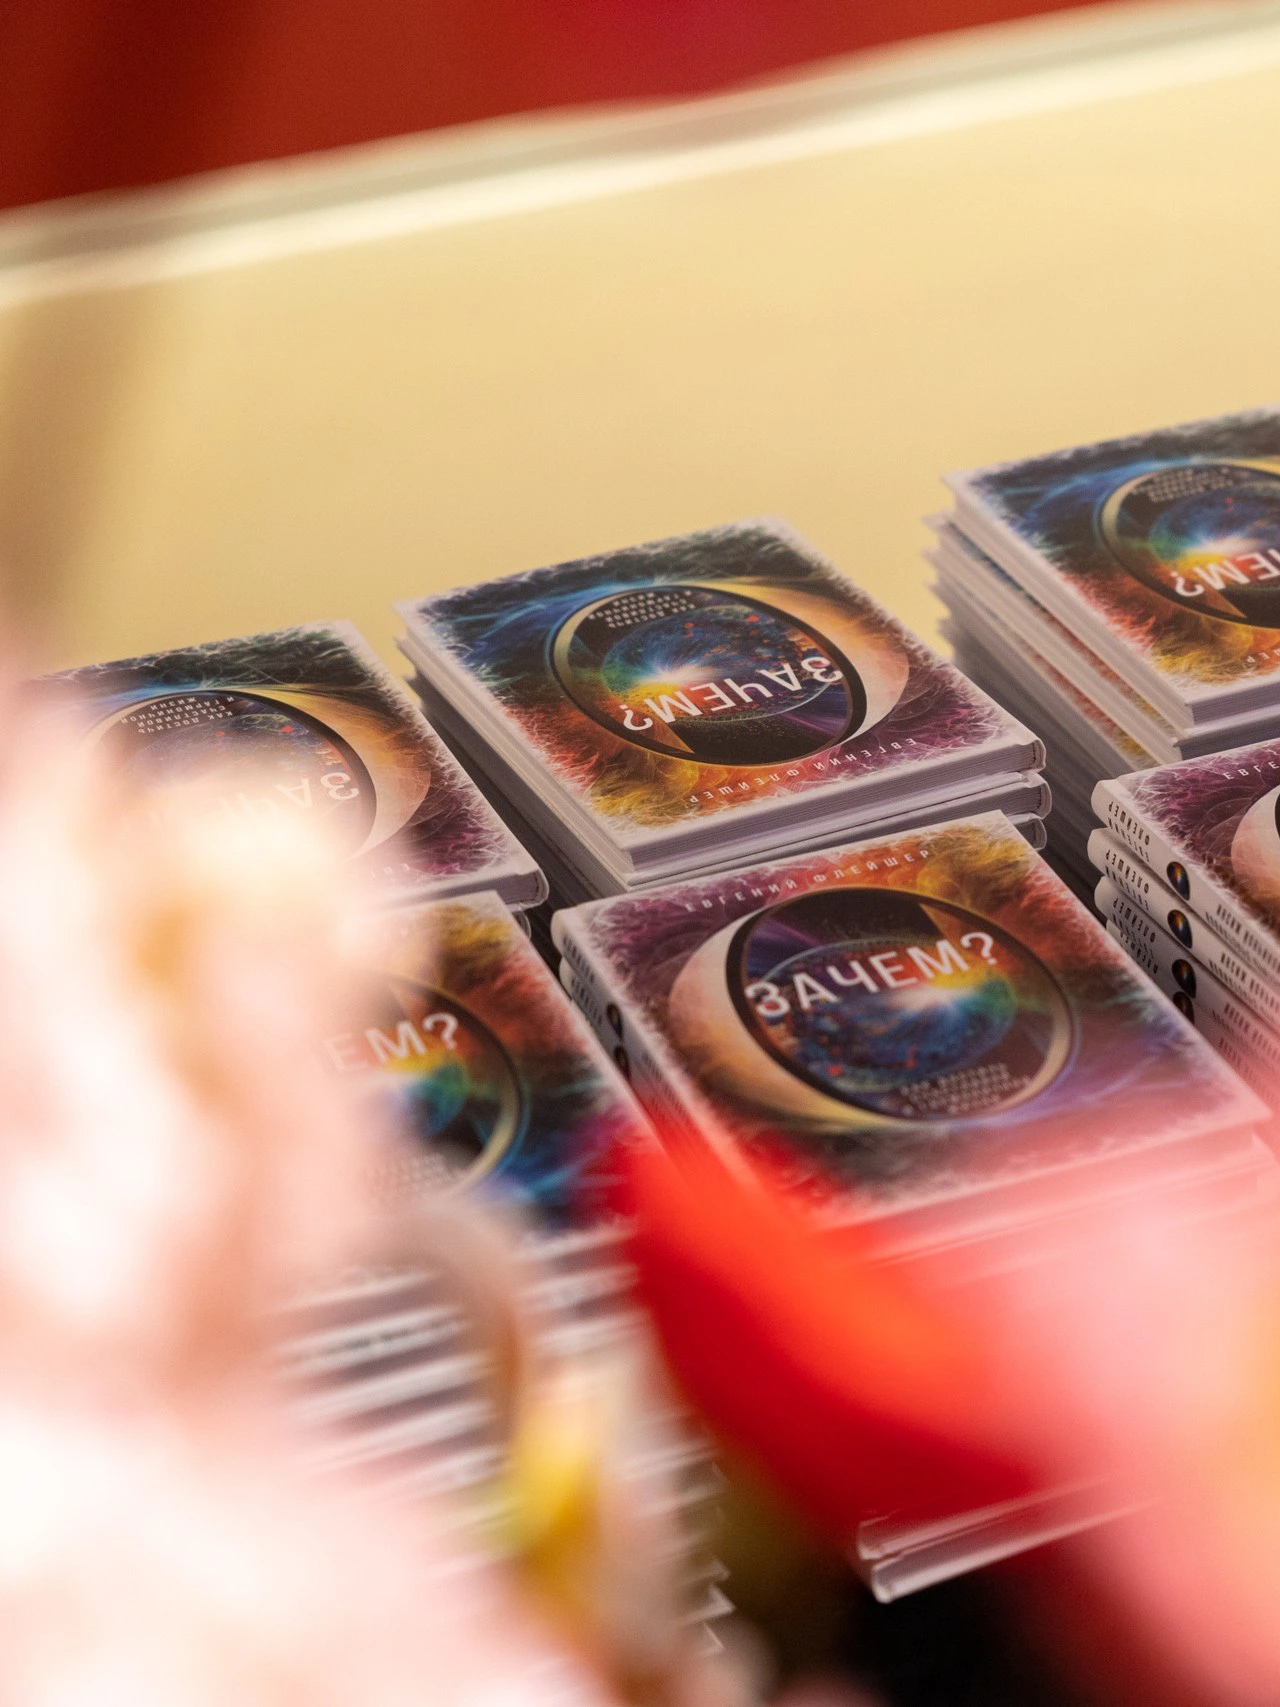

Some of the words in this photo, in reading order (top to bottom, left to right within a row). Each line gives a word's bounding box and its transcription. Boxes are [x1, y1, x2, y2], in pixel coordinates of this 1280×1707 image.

[150, 697, 197, 711] ЖИЗНИ
[619, 657, 843, 732] ЗАЧЕМ?
[137, 705, 226, 727] СЧАСТЛИВОЙ
[138, 717, 199, 734] ДОСТИЧЬ
[207, 711, 233, 720] КАК
[813, 737, 917, 771] ЕВГЕНИЙ
[690, 768, 800, 804] ФЛЕЙШЕР
[685, 878, 798, 913] ЕВГЕНИЙ
[813, 849, 931, 883] ФЛЕЙШЕР
[744, 931, 999, 1019] ЗАЧЕМ?
